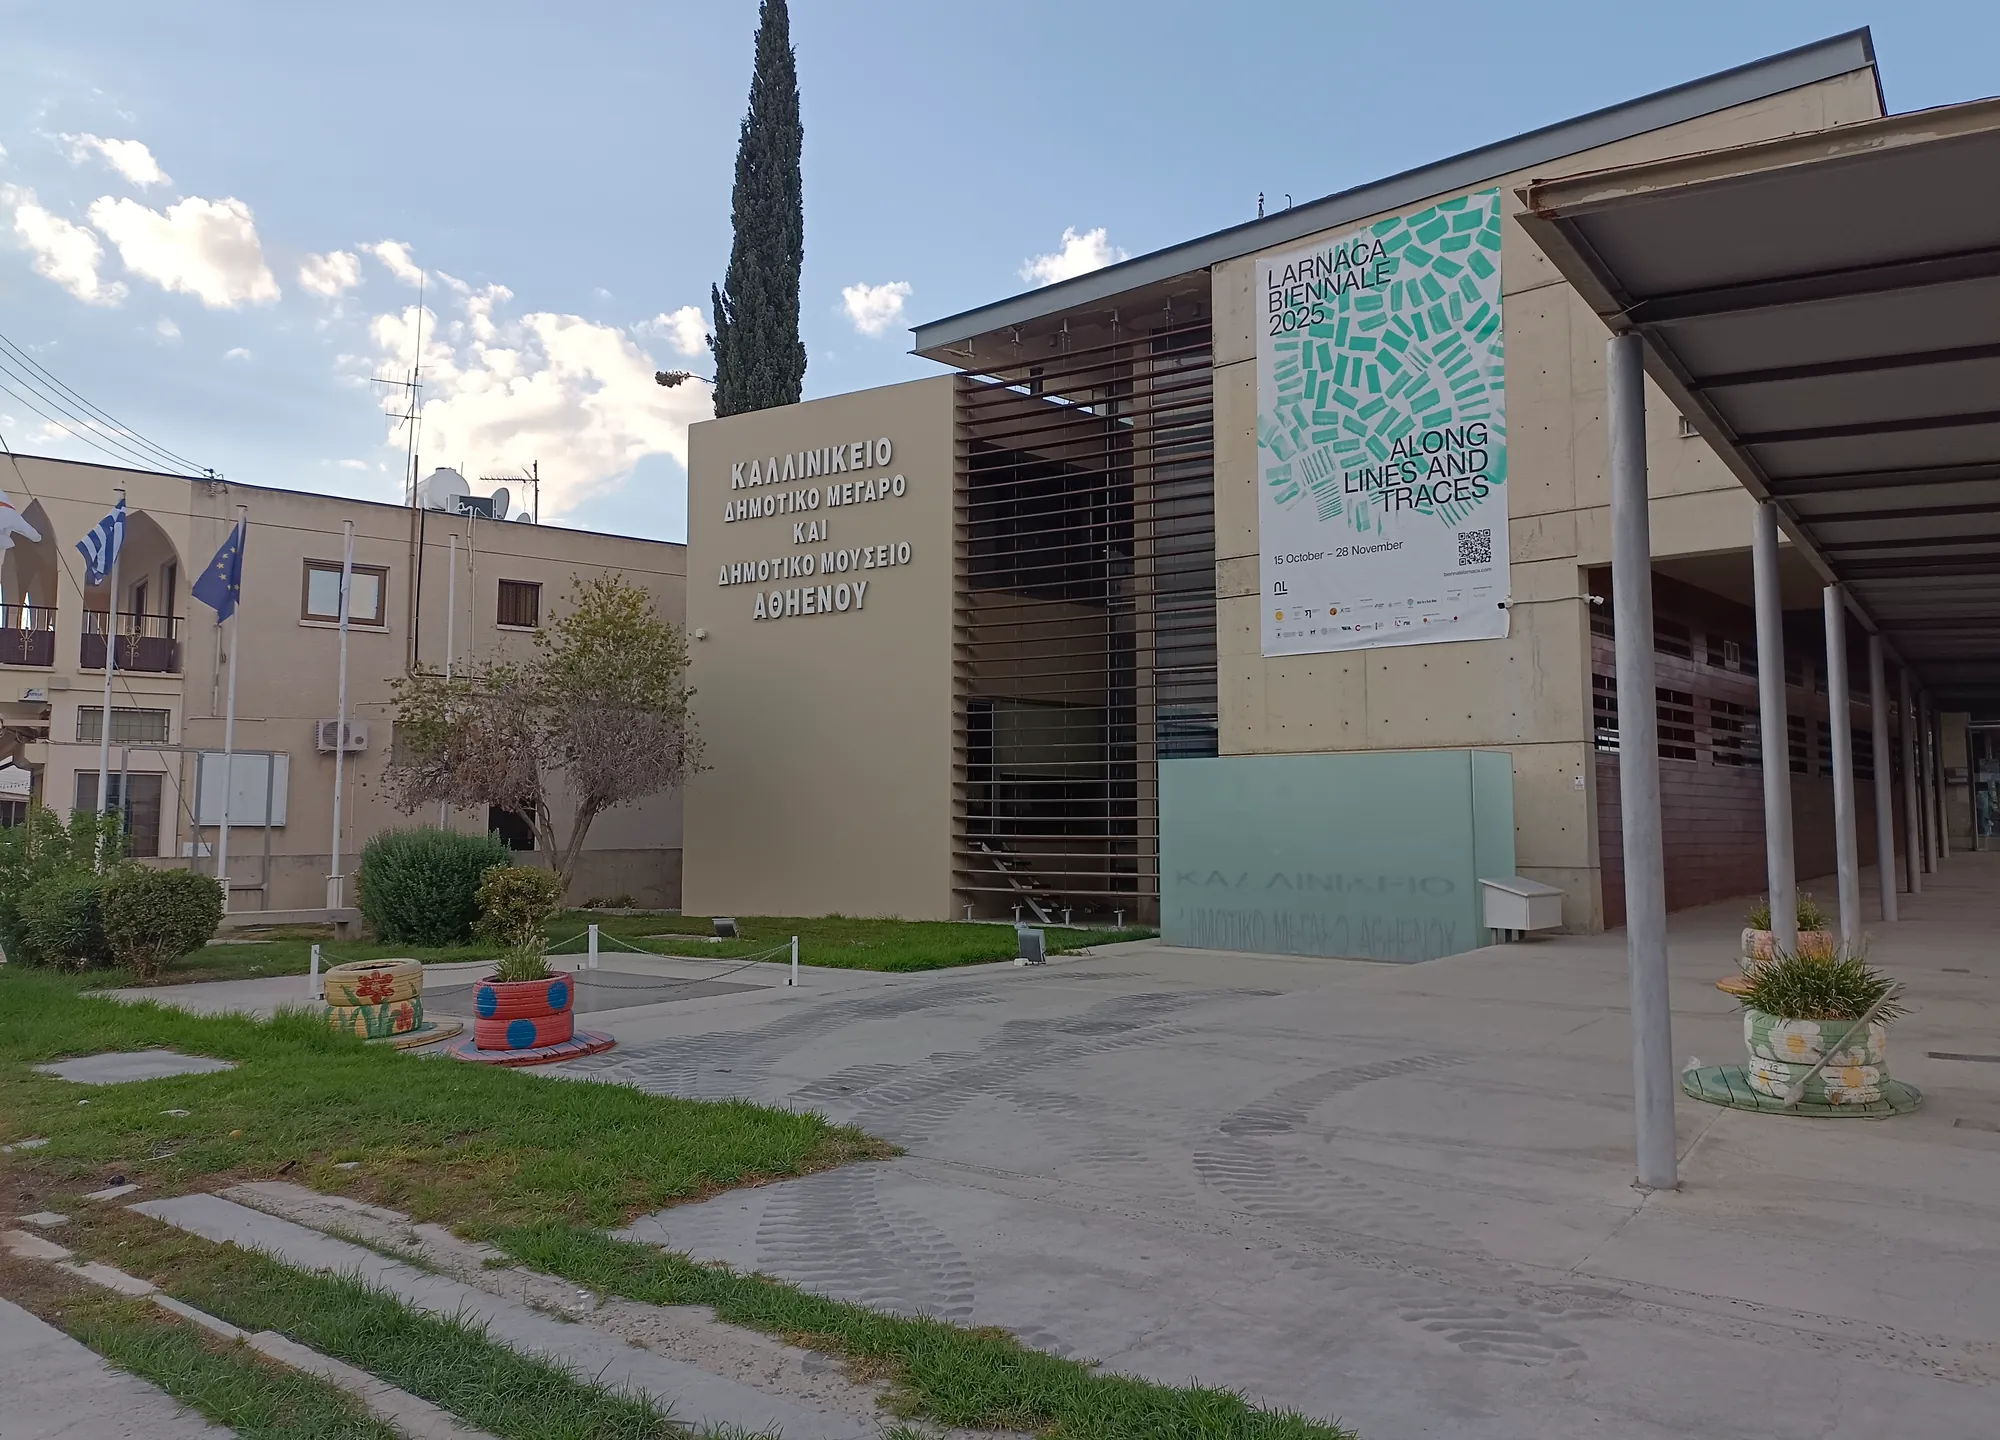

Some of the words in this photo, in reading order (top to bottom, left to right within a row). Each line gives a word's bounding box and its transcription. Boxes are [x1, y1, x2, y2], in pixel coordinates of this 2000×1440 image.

[1268, 239, 1388, 290] LARNACA
[1268, 260, 1391, 313] BIENNALE
[1269, 303, 1325, 336] 2025
[731, 437, 893, 490] ΚΑΛΛΙΝΙΚΕΙΟ
[1390, 423, 1488, 461] ALONG
[1344, 461, 1417, 494] LINES
[1426, 449, 1488, 481] AND
[1378, 475, 1489, 512] TRACES
[724, 487, 820, 523] ΔΗΜΟΤΙΚΟ
[827, 474, 907, 507] ΜΕΓΑΡΟ
[793, 519, 828, 544] ΚΑΙ
[1274, 555, 1284, 565] 15
[1286, 551, 1324, 563] October
[1336, 547, 1349, 557] 28
[1351, 541, 1404, 555] November
[718, 554, 816, 586] ΔΗΜΟΤΙΚΟ
[821, 541, 912, 574] ΜΟΥΣΕΙΟ
[753, 581, 869, 620] ΑΘΗΕΝΟΥ
[1178, 906, 1266, 951] ΗΜΟΤΙΚΟ
